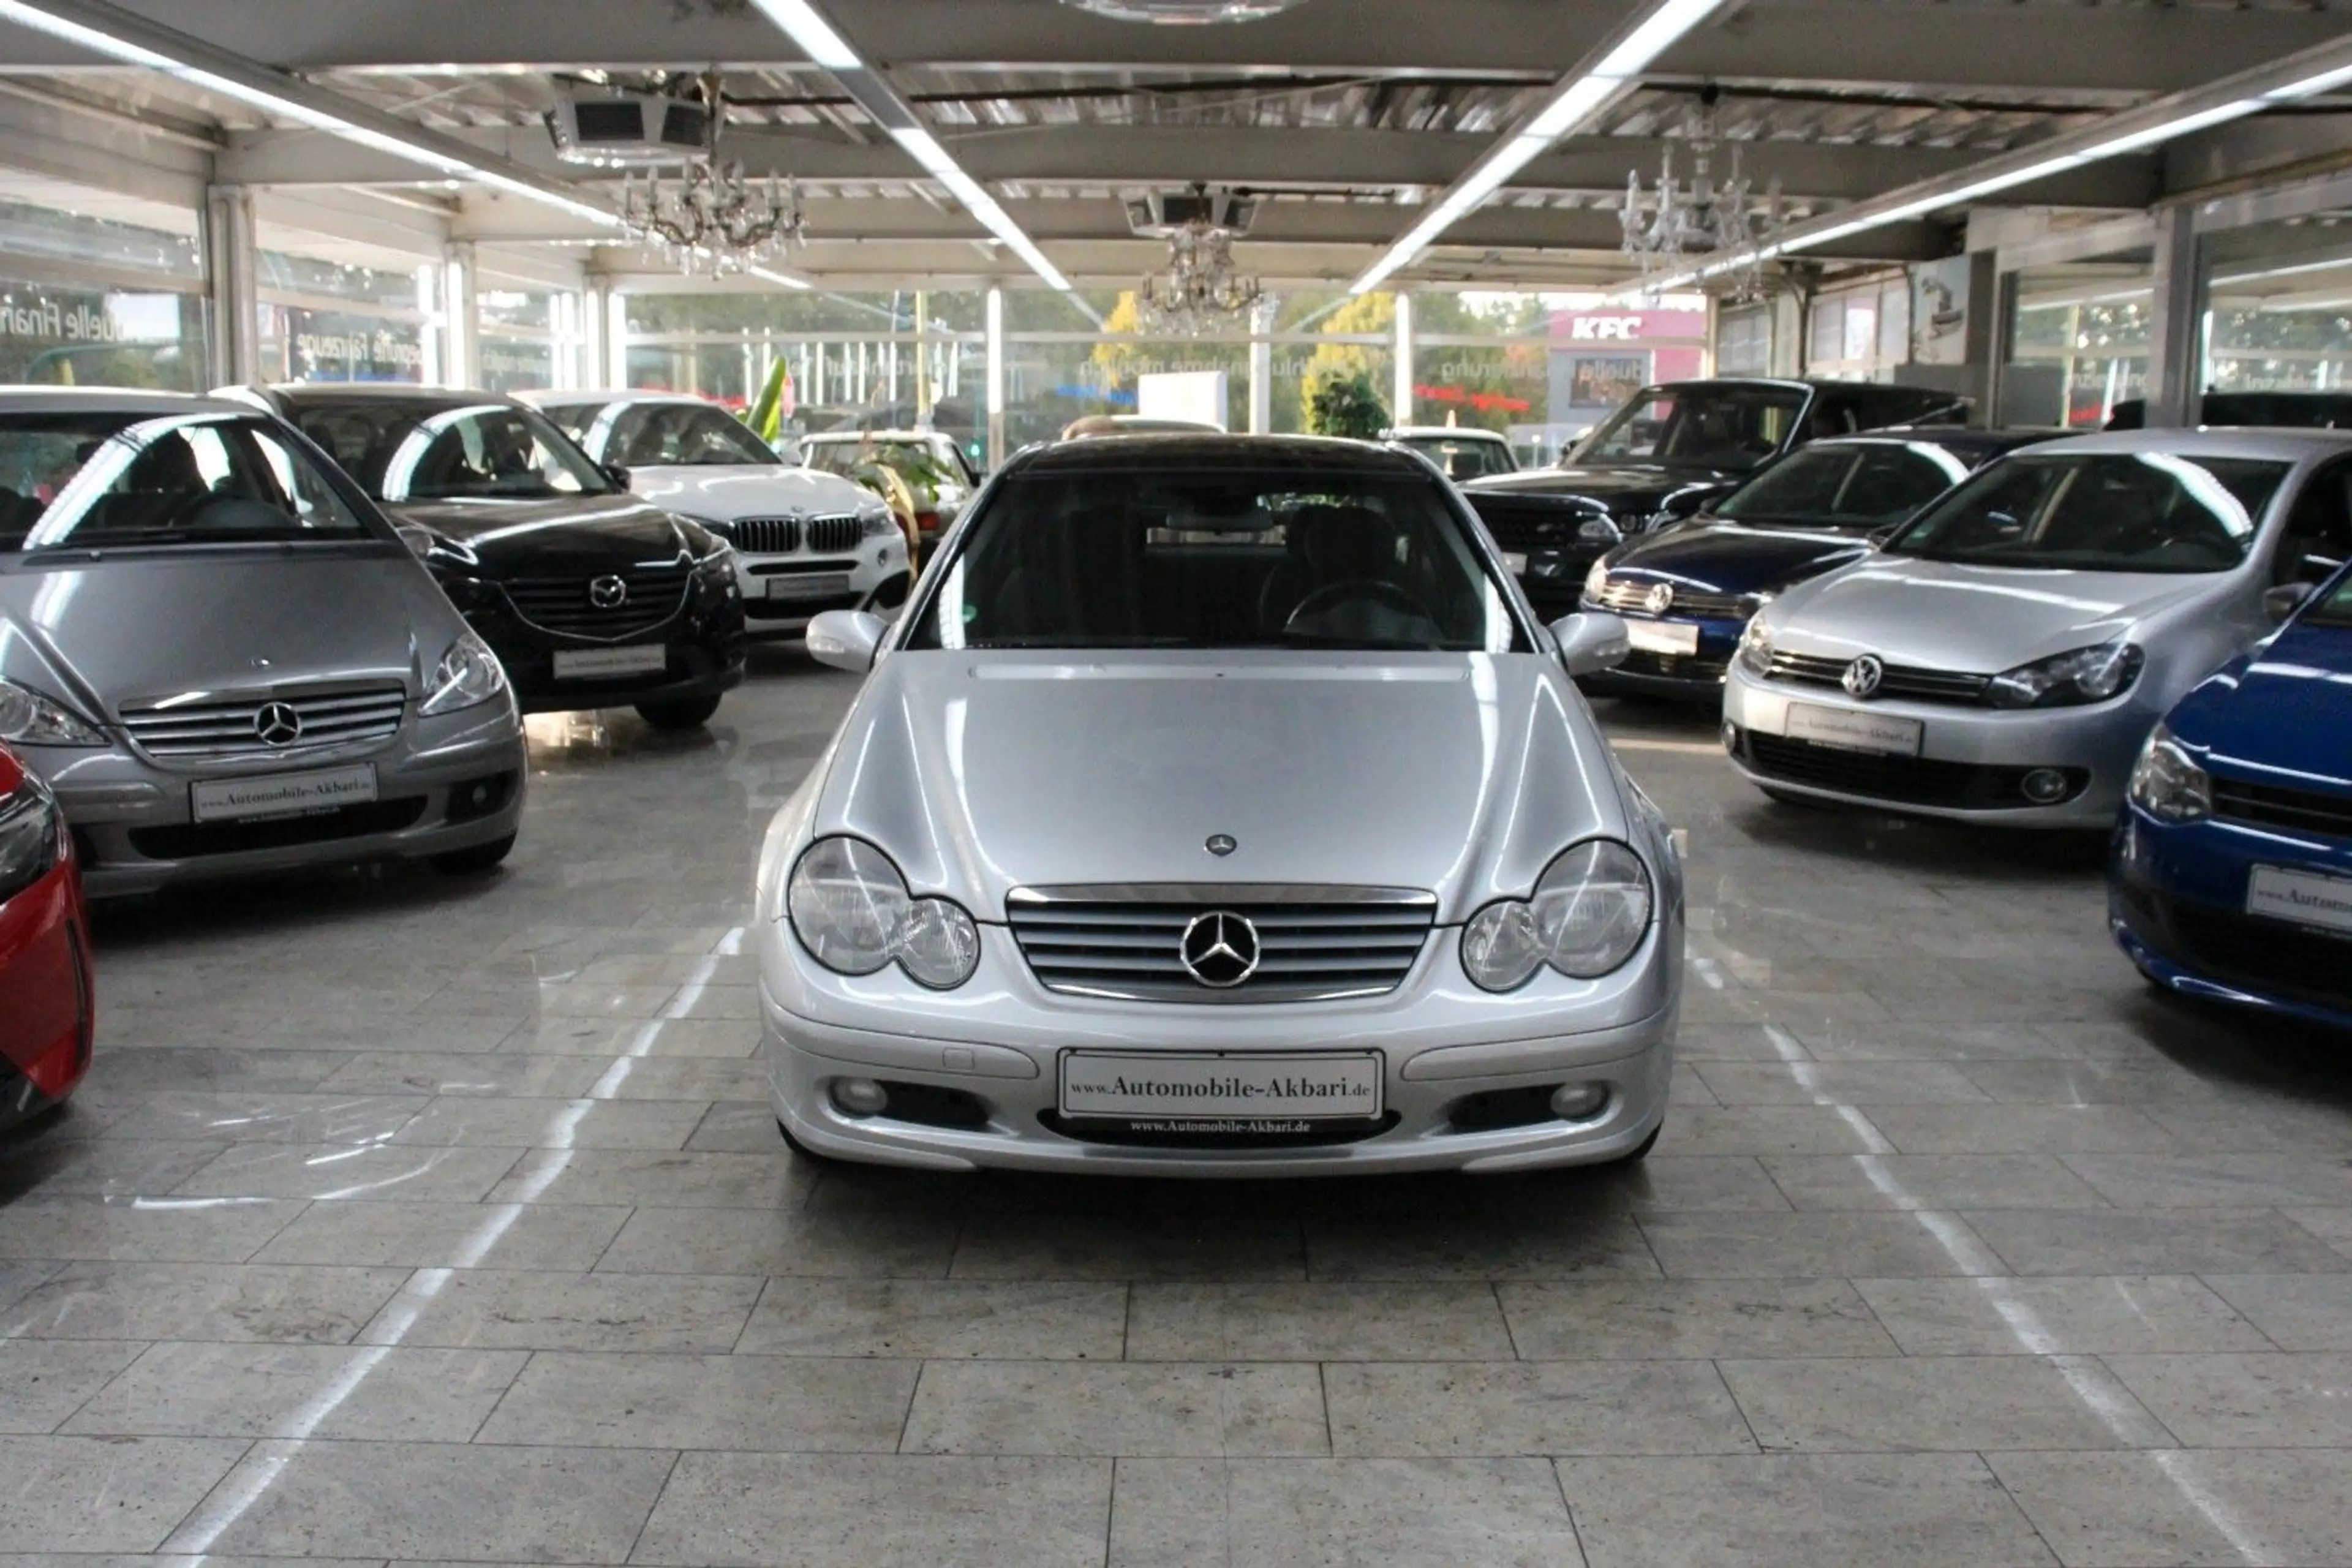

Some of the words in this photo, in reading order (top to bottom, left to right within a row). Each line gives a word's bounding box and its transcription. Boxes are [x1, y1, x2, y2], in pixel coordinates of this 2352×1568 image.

[1572, 316, 1643, 339] KFC
[1071, 1076, 1371, 1098] www.Automobile-Akbari.de
[1130, 1120, 1311, 1133] www.Automobile-Akbari.de
